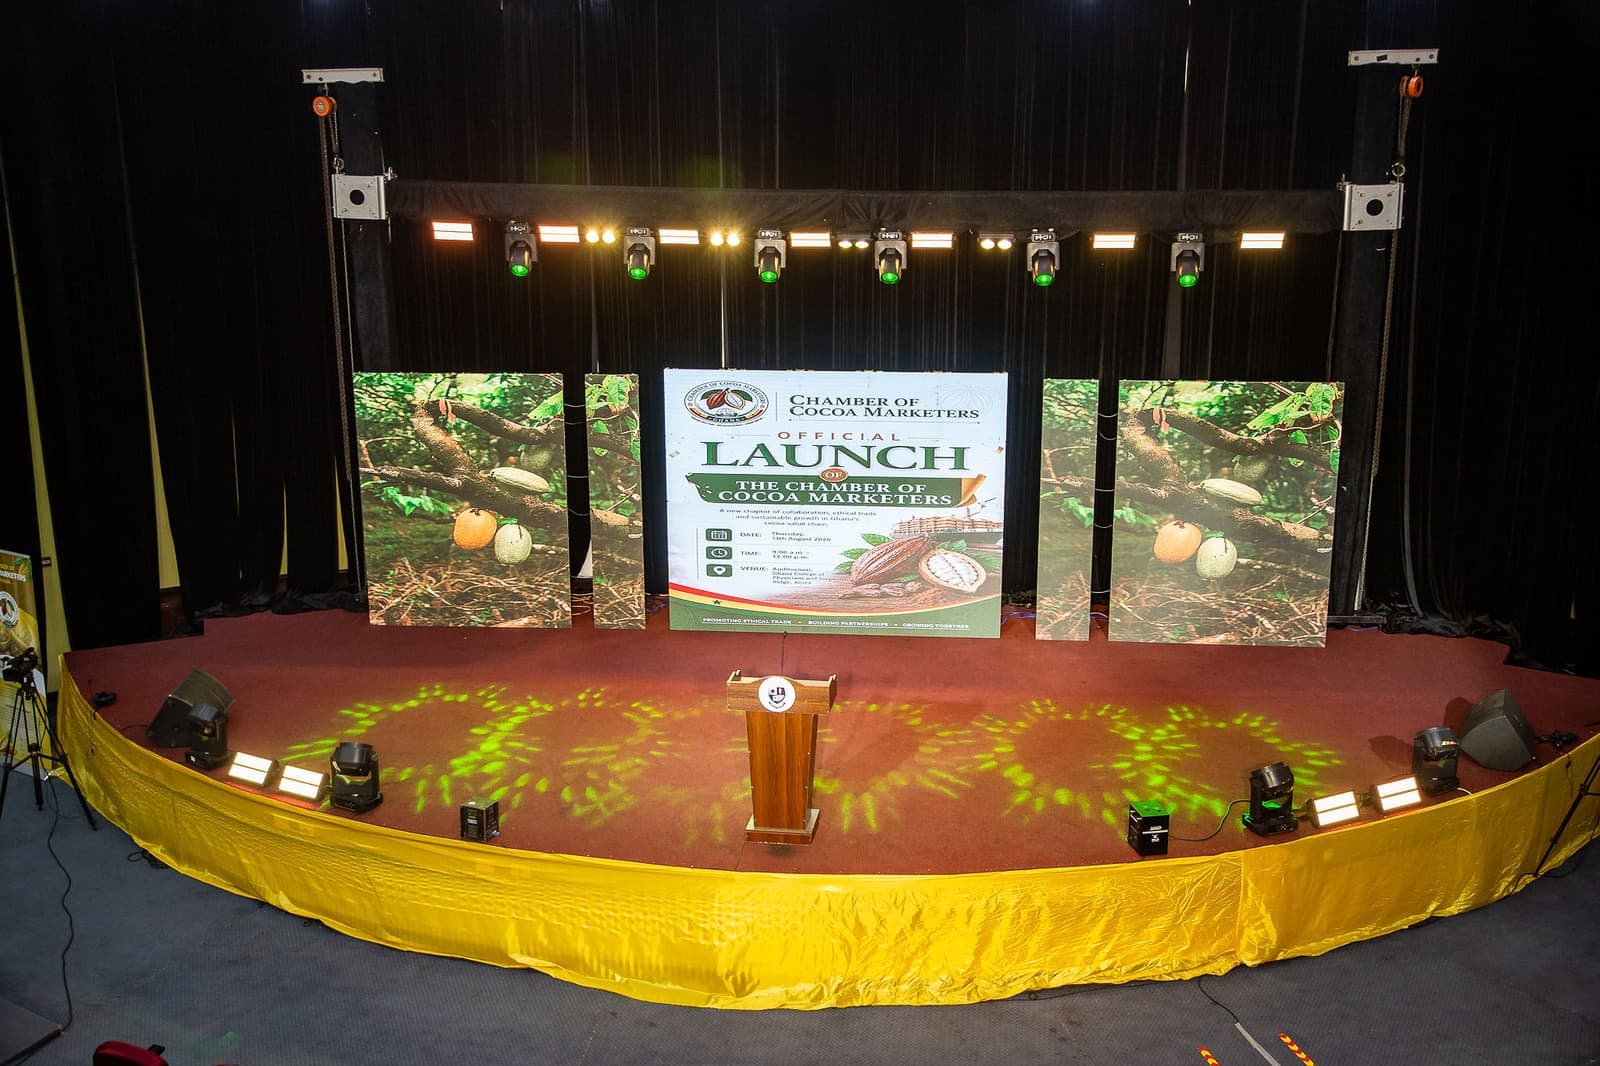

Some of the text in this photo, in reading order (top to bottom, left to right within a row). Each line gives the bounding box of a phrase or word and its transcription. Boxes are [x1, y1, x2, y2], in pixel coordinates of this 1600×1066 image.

[789, 394, 920, 406] CHAMBER OF
[789, 406, 980, 418] COCOA MARKETERS
[777, 431, 901, 442] OFFICIAL
[700, 441, 970, 470] LAUNCH
[736, 480, 927, 494] THE CHAMBER OF
[718, 490, 952, 506] COCOA MARKETERS
